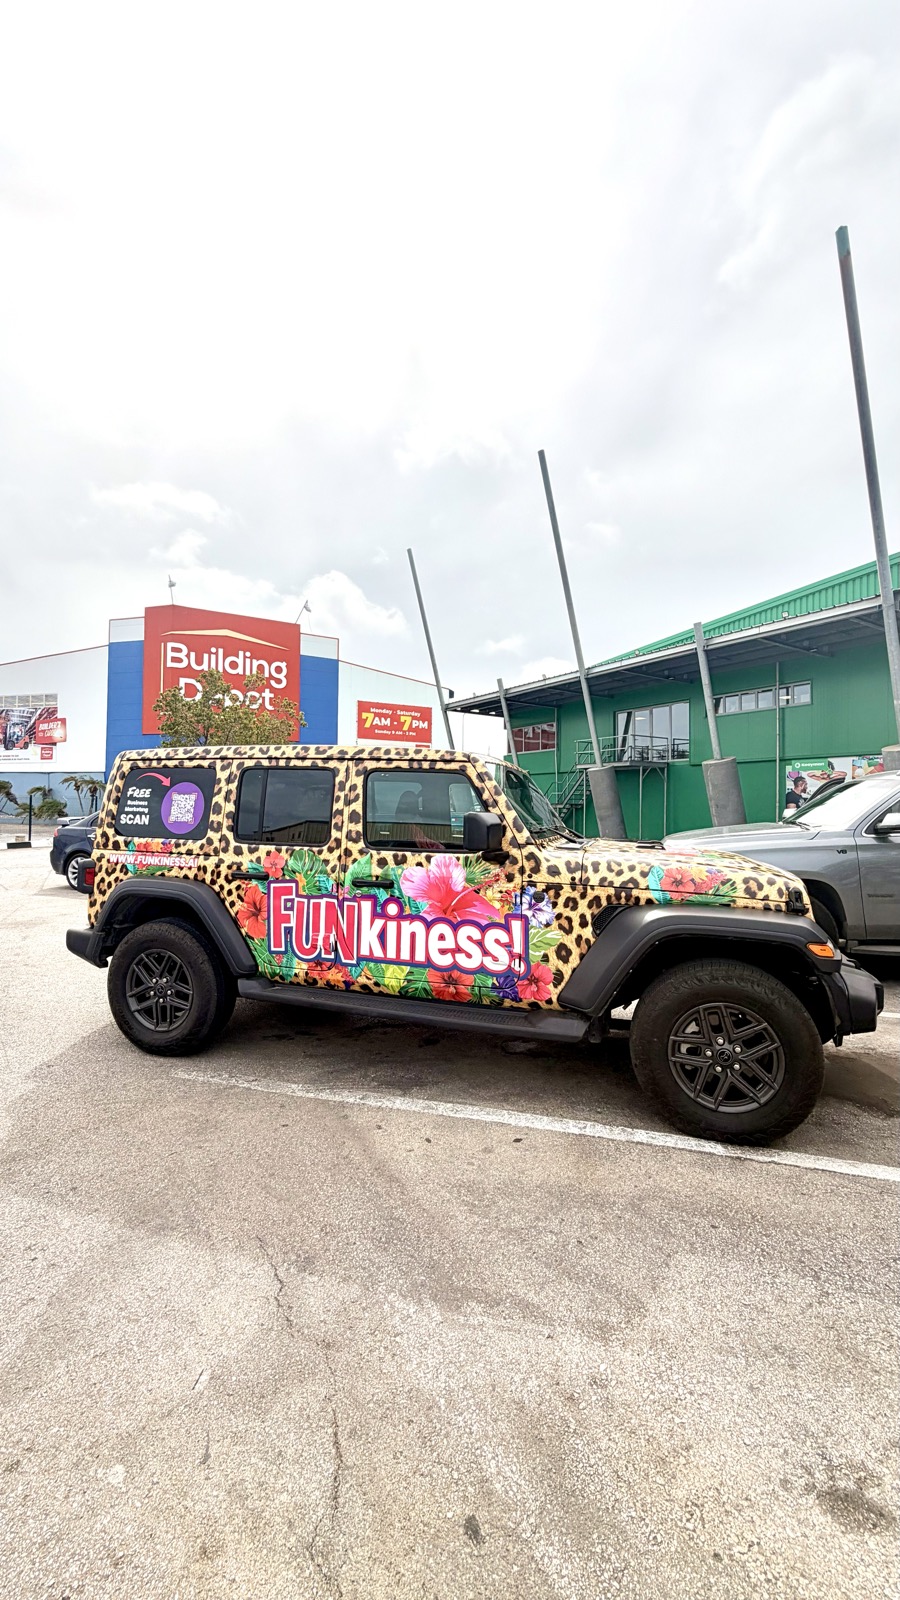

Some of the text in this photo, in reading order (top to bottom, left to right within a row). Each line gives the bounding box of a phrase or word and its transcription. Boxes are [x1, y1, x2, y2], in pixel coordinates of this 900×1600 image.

[166, 642, 287, 689] Building
[178, 677, 275, 710] Dpot
[370, 707, 392, 715] Monday
[361, 712, 391, 728] 7AM
[400, 715, 428, 731] 7PM
[127, 786, 152, 798] FREE
[124, 806, 149, 814] Marketing
[120, 814, 150, 825] SCAN
[109, 854, 198, 867] WWW.FUNKINESS.AI
[268, 881, 527, 977] FUNkiness!
